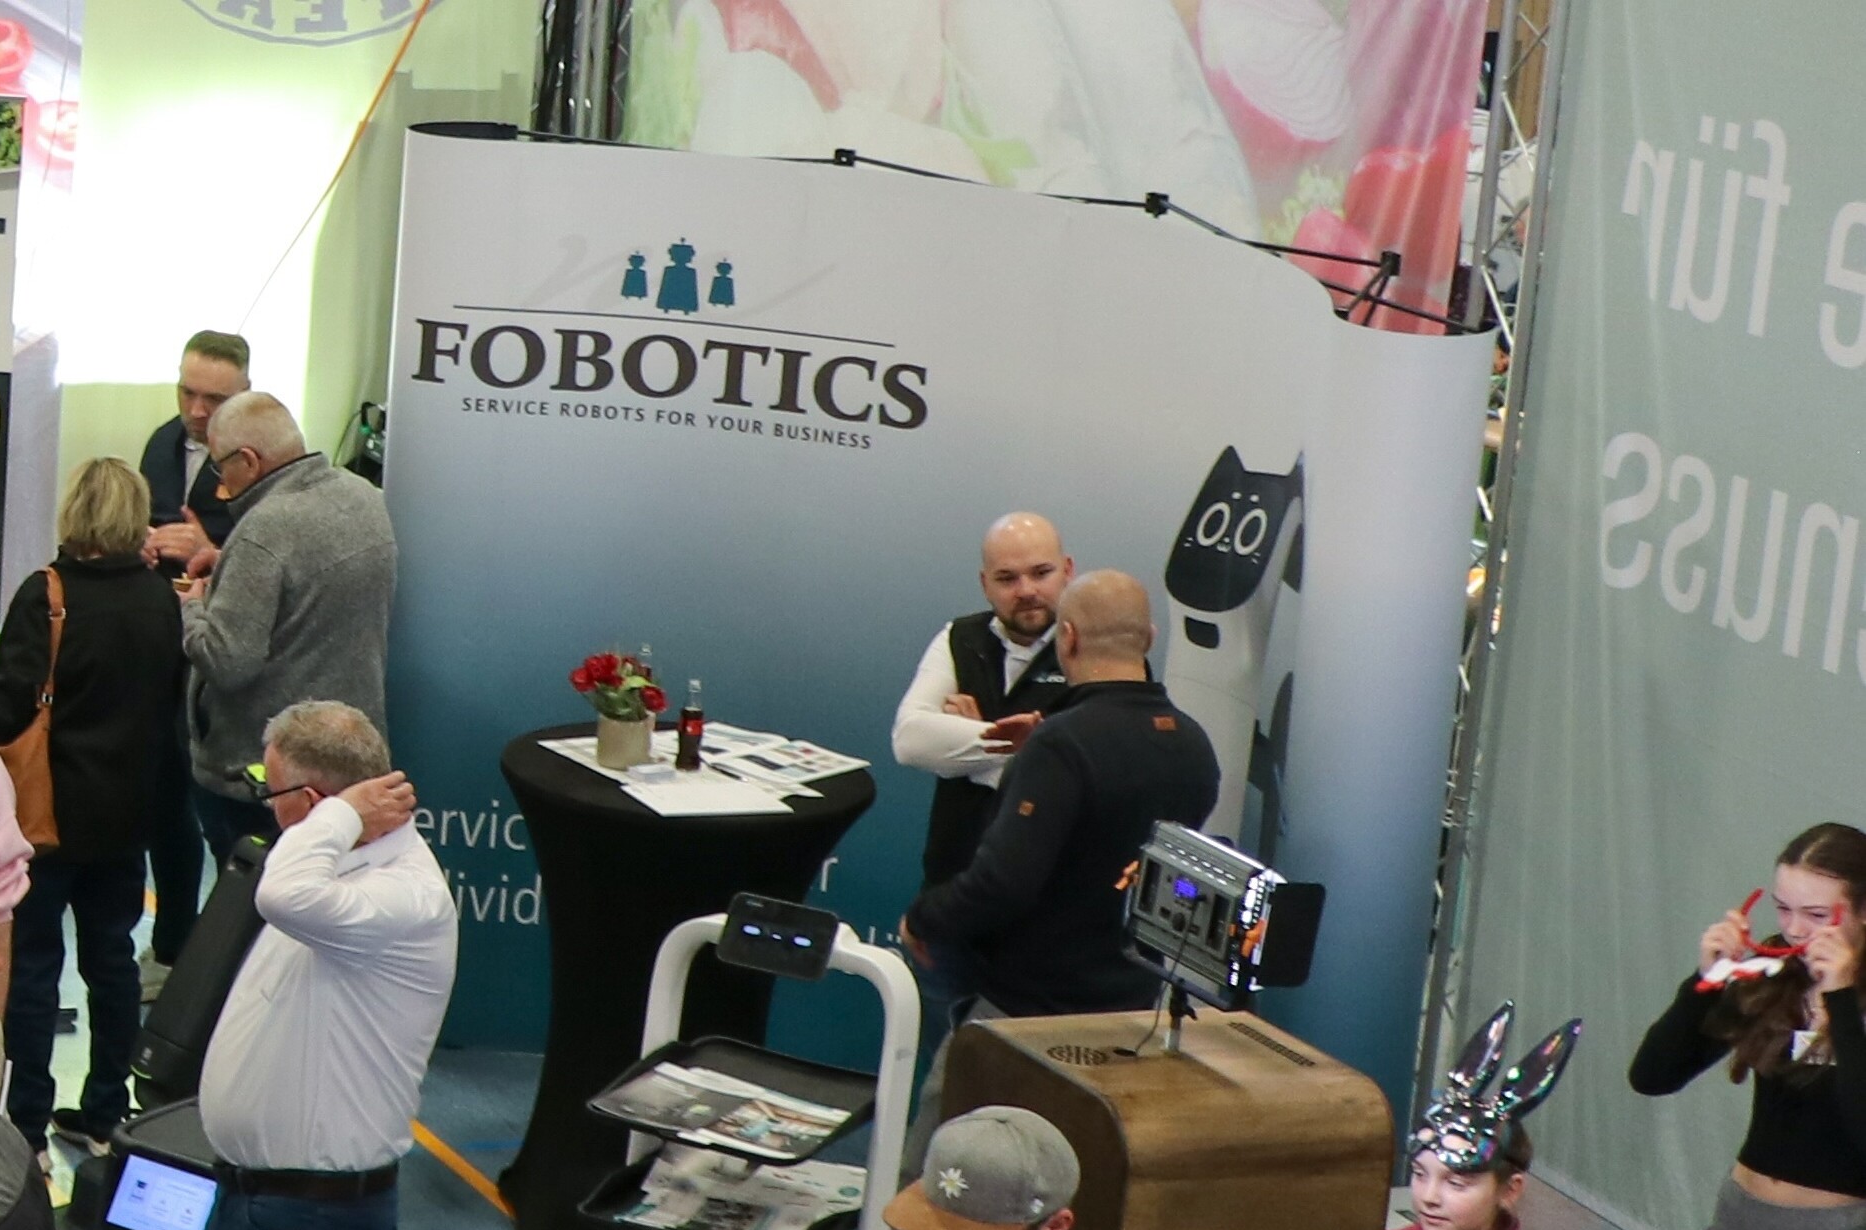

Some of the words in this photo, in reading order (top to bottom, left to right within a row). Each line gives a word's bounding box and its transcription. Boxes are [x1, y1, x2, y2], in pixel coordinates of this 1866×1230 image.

[411, 317, 928, 431] FOBOTICS
[462, 397, 550, 418] SERVICE
[559, 401, 646, 423] ROBOTS
[656, 409, 697, 428] FOR
[707, 414, 765, 436] YOUR
[773, 423, 872, 450] BUSINESS
[412, 799, 527, 852] ervic
